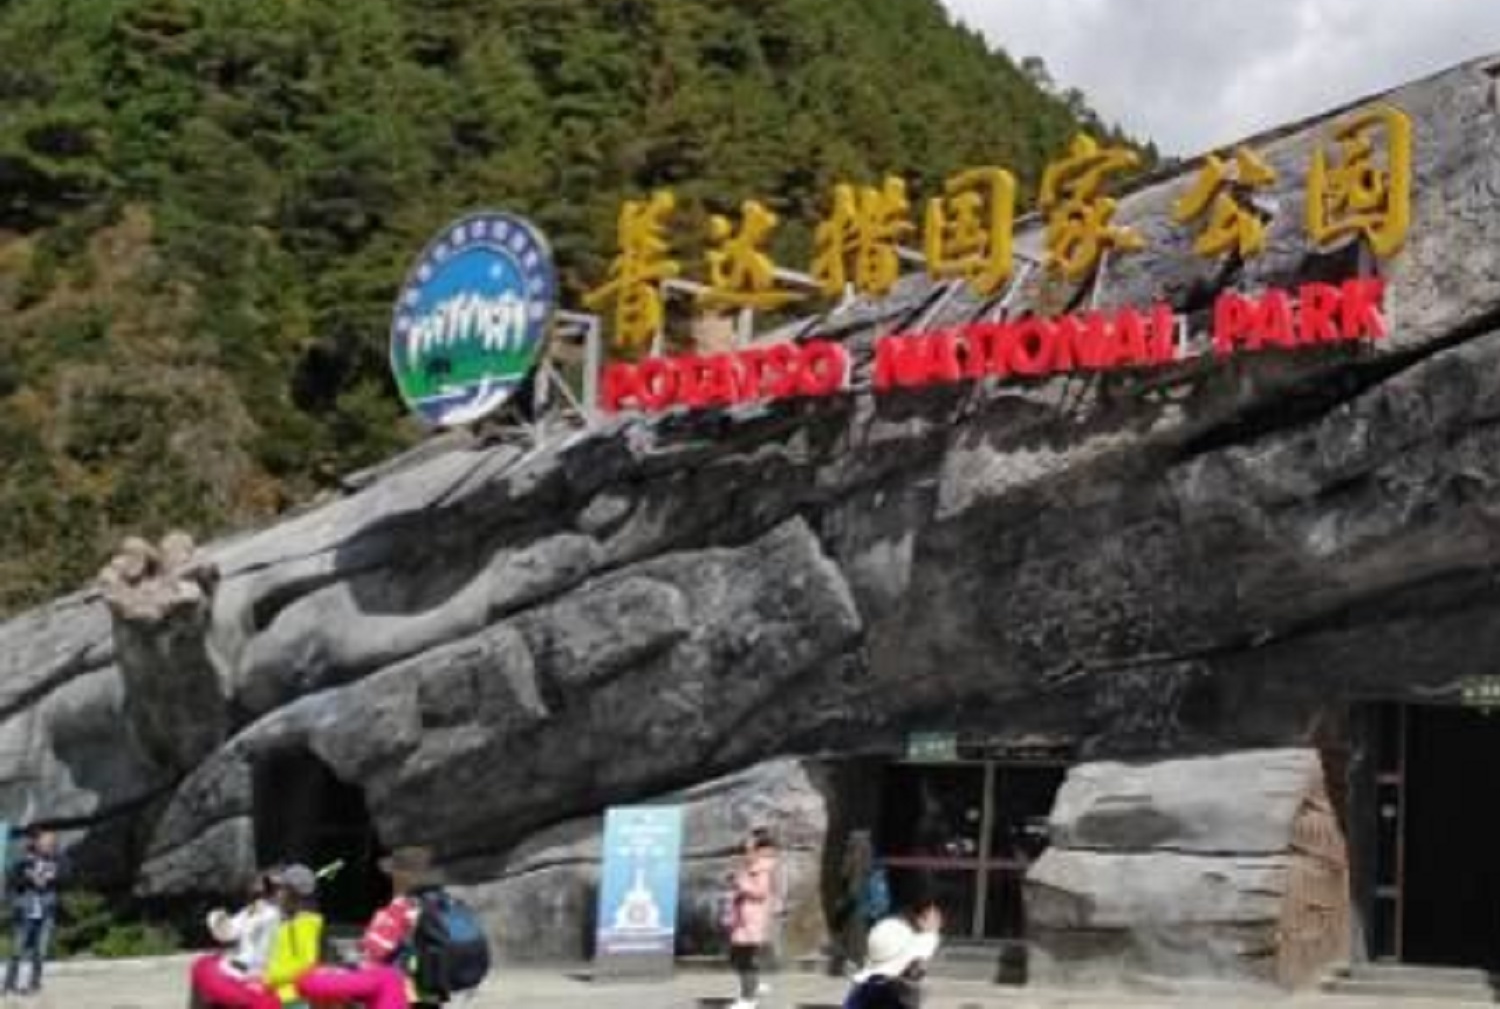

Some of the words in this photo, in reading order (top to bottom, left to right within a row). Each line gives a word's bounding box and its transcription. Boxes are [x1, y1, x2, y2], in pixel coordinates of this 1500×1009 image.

[583, 104, 1415, 346] 普达措国家公园
[602, 339, 846, 412] POTATSO
[873, 303, 1178, 390] NATIONAL
[1213, 277, 1385, 354] PARK
